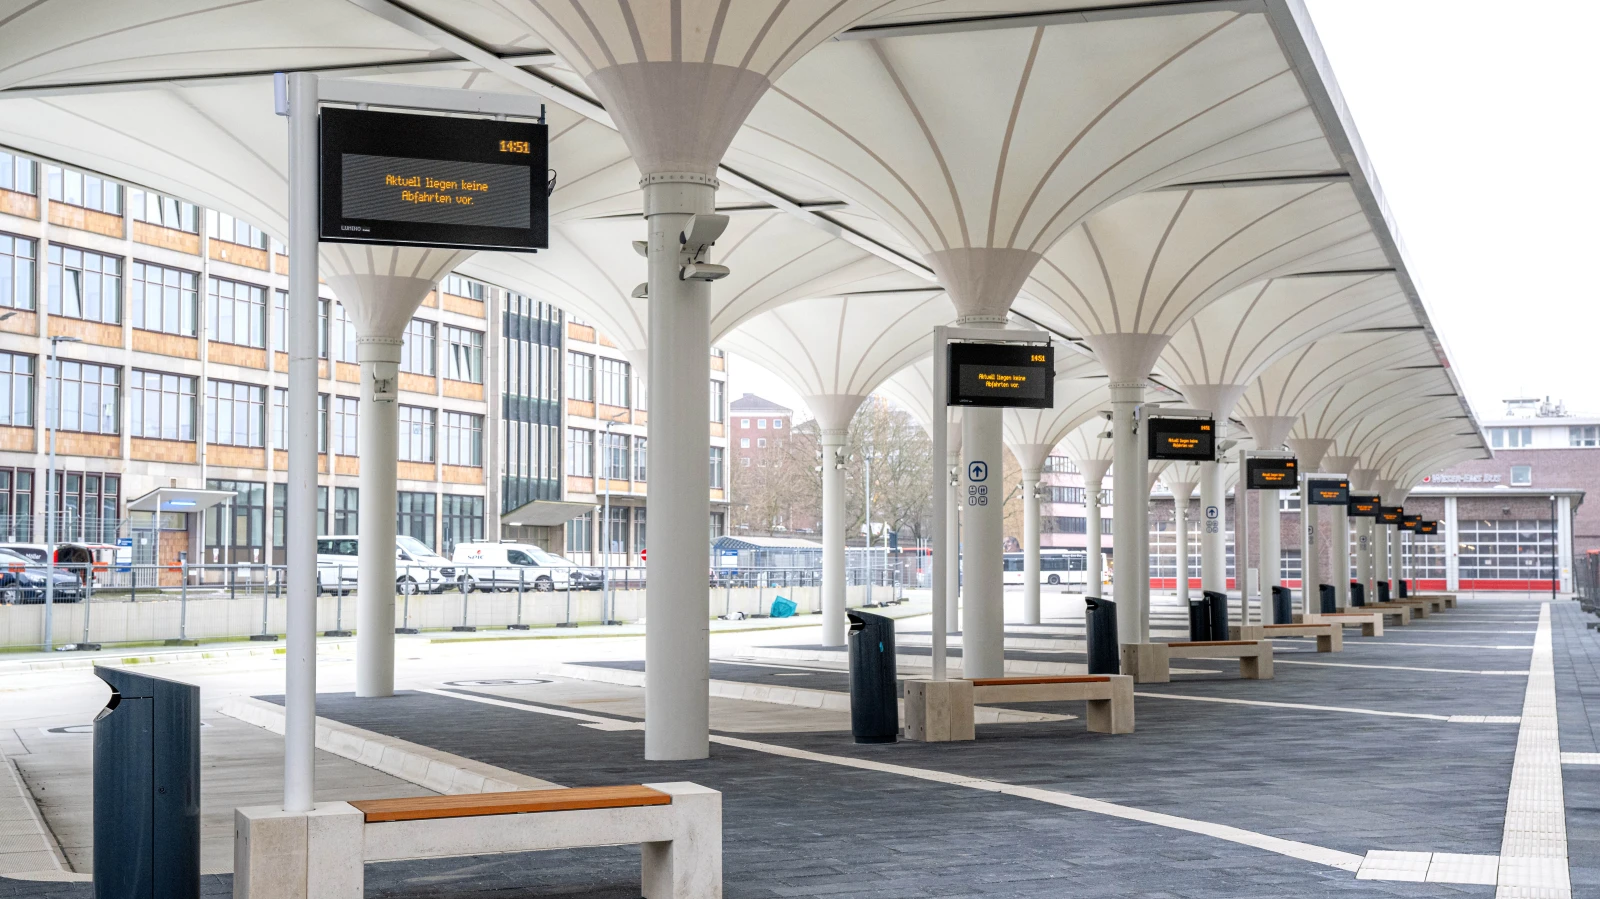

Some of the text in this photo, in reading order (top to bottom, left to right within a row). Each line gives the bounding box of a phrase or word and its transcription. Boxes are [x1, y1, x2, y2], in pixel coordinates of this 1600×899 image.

[500, 140, 530, 154] 14:51
[385, 174, 489, 192] Aktuell liegen keine
[402, 190, 474, 205] Abfahrten vor.
